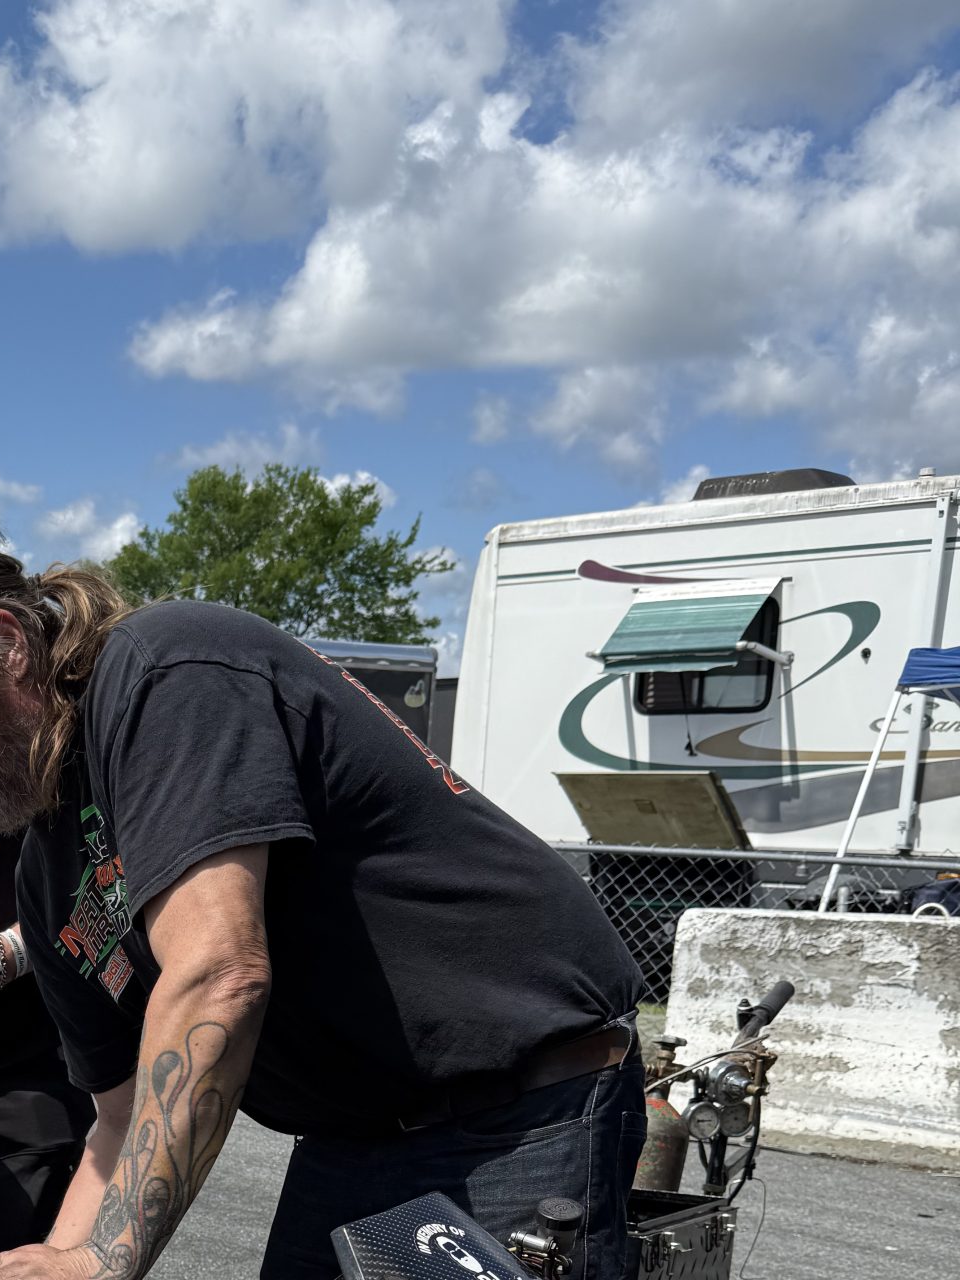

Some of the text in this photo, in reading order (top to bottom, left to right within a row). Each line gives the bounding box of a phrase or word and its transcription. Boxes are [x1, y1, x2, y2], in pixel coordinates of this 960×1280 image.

[416, 1223, 466, 1255] IN MEMORY OF
